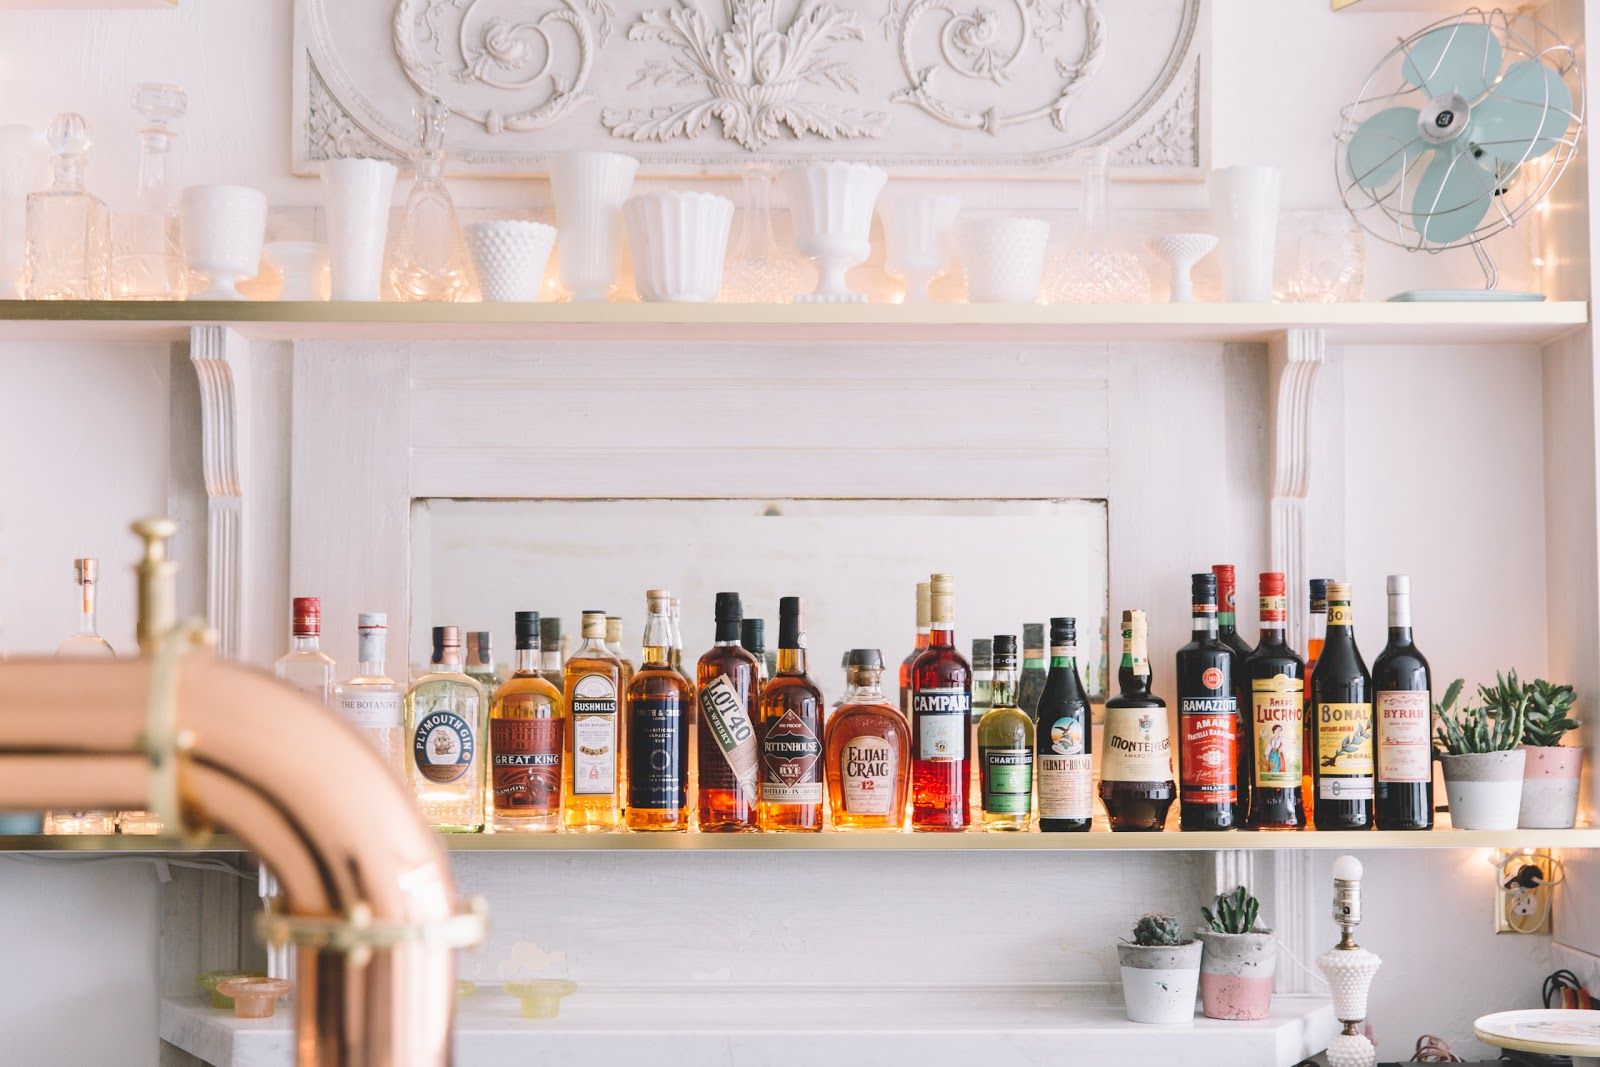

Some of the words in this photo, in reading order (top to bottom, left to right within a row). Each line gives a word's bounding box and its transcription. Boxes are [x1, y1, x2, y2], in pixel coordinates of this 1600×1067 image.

[341, 701, 354, 709] THE
[356, 701, 397, 709] BOTANIST
[574, 702, 615, 711] BUSHMILLS
[914, 696, 970, 711] CAMPARI
[1270, 698, 1293, 706] AMARO
[709, 678, 739, 716] LOT
[729, 714, 751, 742] 40
[1256, 704, 1303, 723] LUCANO
[1321, 705, 1368, 722] BONAL
[1384, 710, 1424, 718] BYRRH
[703, 695, 712, 713] RYE
[711, 712, 732, 745] WHISKY
[1196, 719, 1230, 729] AMARO
[416, 714, 463, 749] PLYMOUTH
[460, 728, 472, 750] GIN
[764, 742, 818, 752] RITTENHOUSE
[1111, 735, 1170, 752] MONTENEG
[495, 755, 531, 764] GREAT
[534, 755, 559, 764] KING
[848, 746, 889, 763] ELIJAH
[779, 767, 802, 775] RYE
[847, 761, 889, 778] CRAIG
[861, 780, 874, 790] 12
